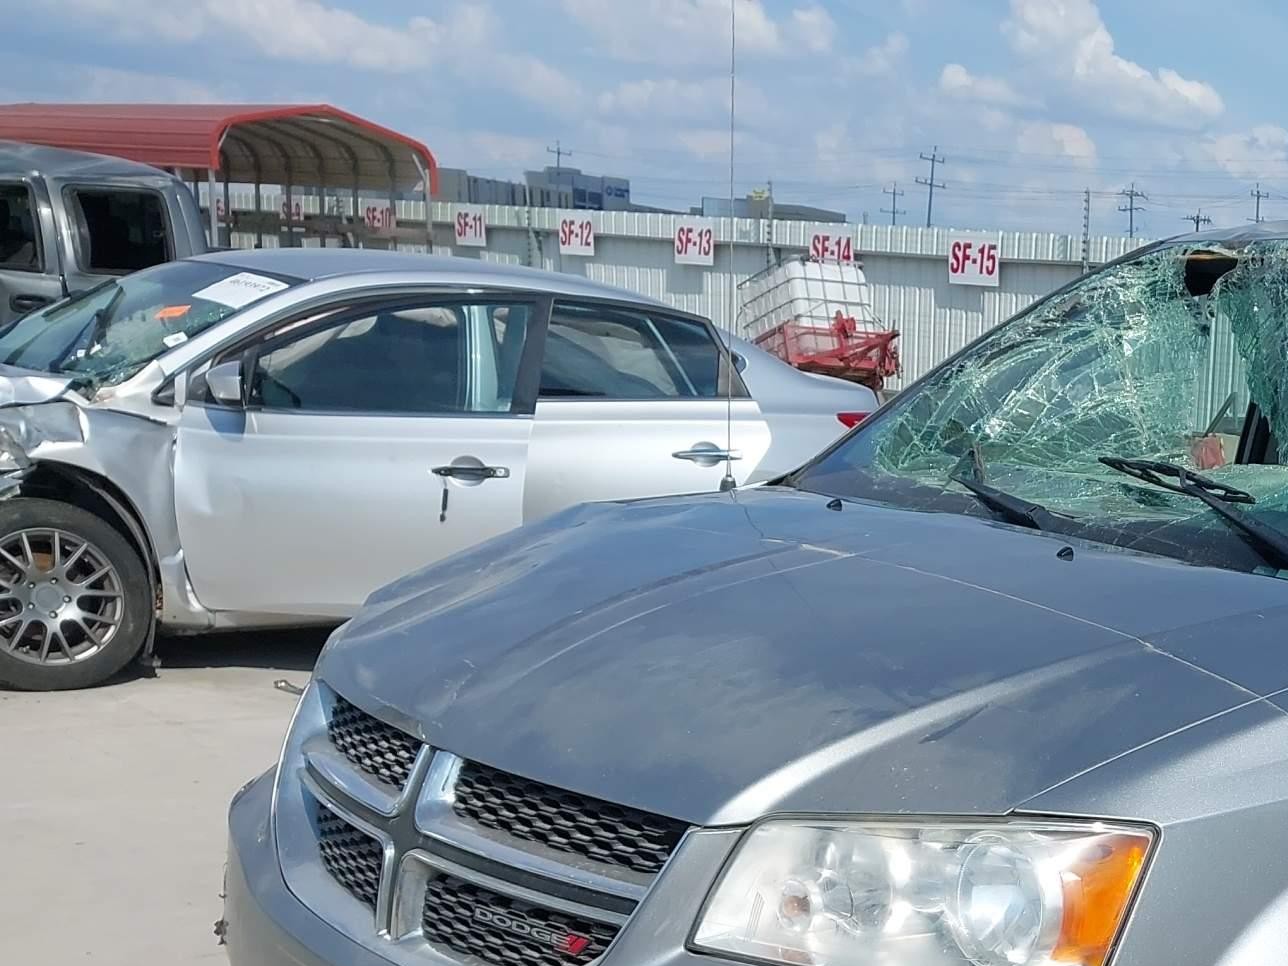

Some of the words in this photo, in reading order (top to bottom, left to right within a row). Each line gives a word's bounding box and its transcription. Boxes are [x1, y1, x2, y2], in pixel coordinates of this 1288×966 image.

[456, 211, 483, 239] SF-11
[560, 219, 592, 248] SF-12
[675, 226, 713, 257] SF-13
[811, 234, 852, 261] SF-14
[950, 240, 997, 277] SF-15
[474, 907, 571, 949] DODGE
